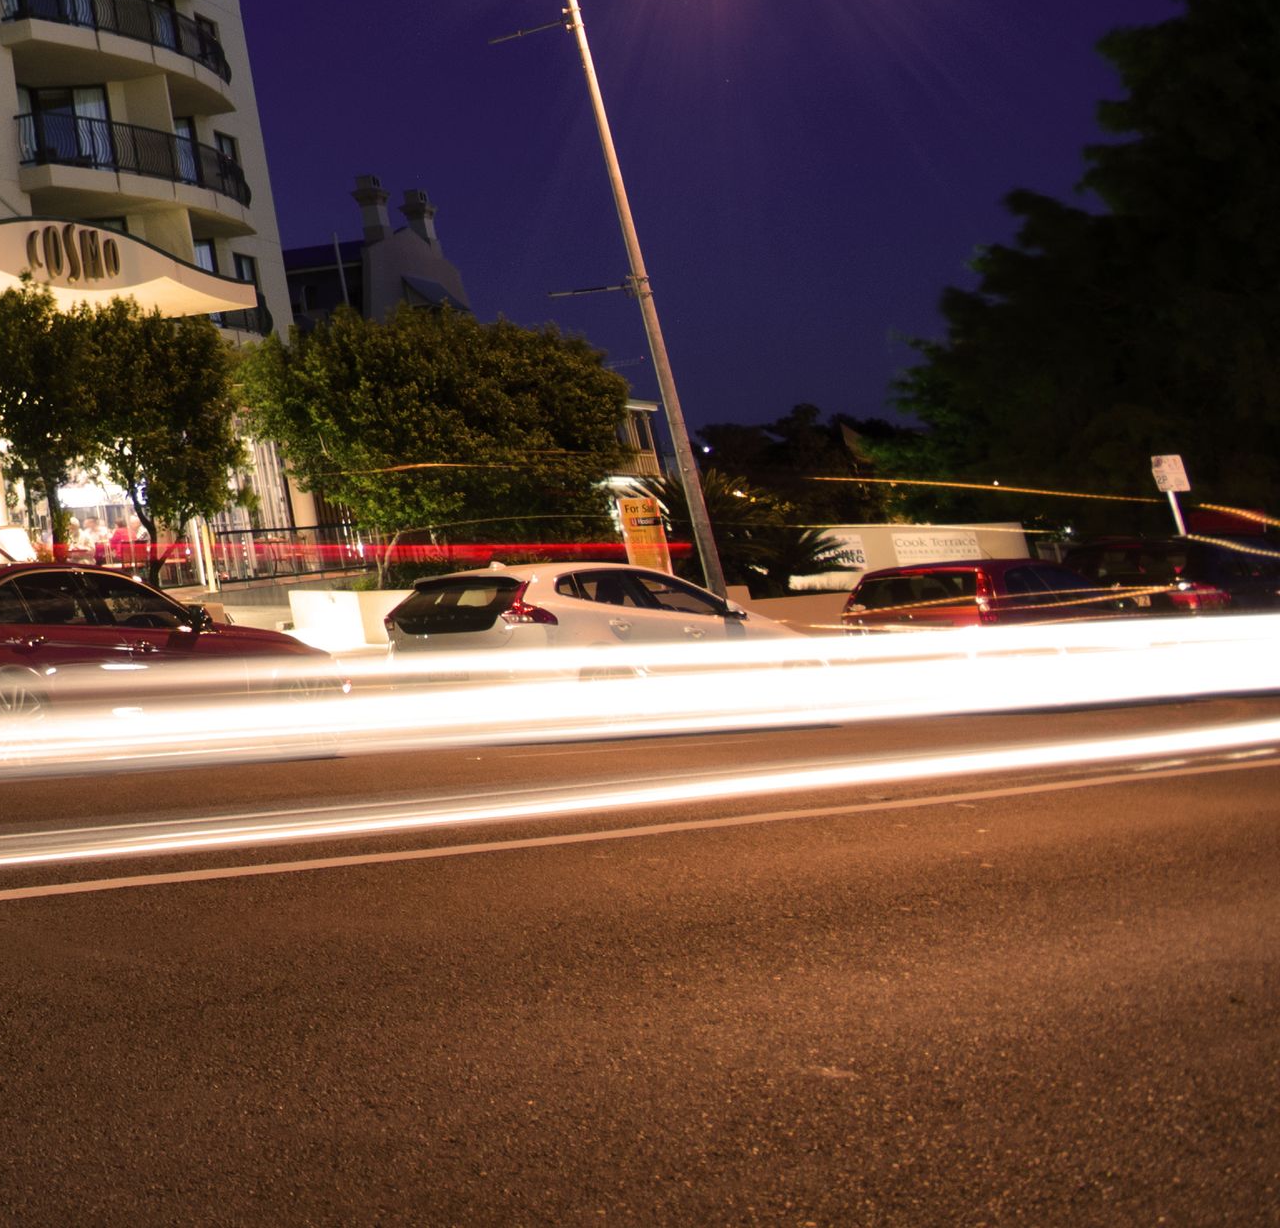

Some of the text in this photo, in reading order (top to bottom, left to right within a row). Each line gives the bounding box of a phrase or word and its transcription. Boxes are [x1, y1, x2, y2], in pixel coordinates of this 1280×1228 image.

[26, 223, 121, 284] COSMO
[624, 504, 639, 513] For
[895, 537, 976, 547] Cook Terrace
